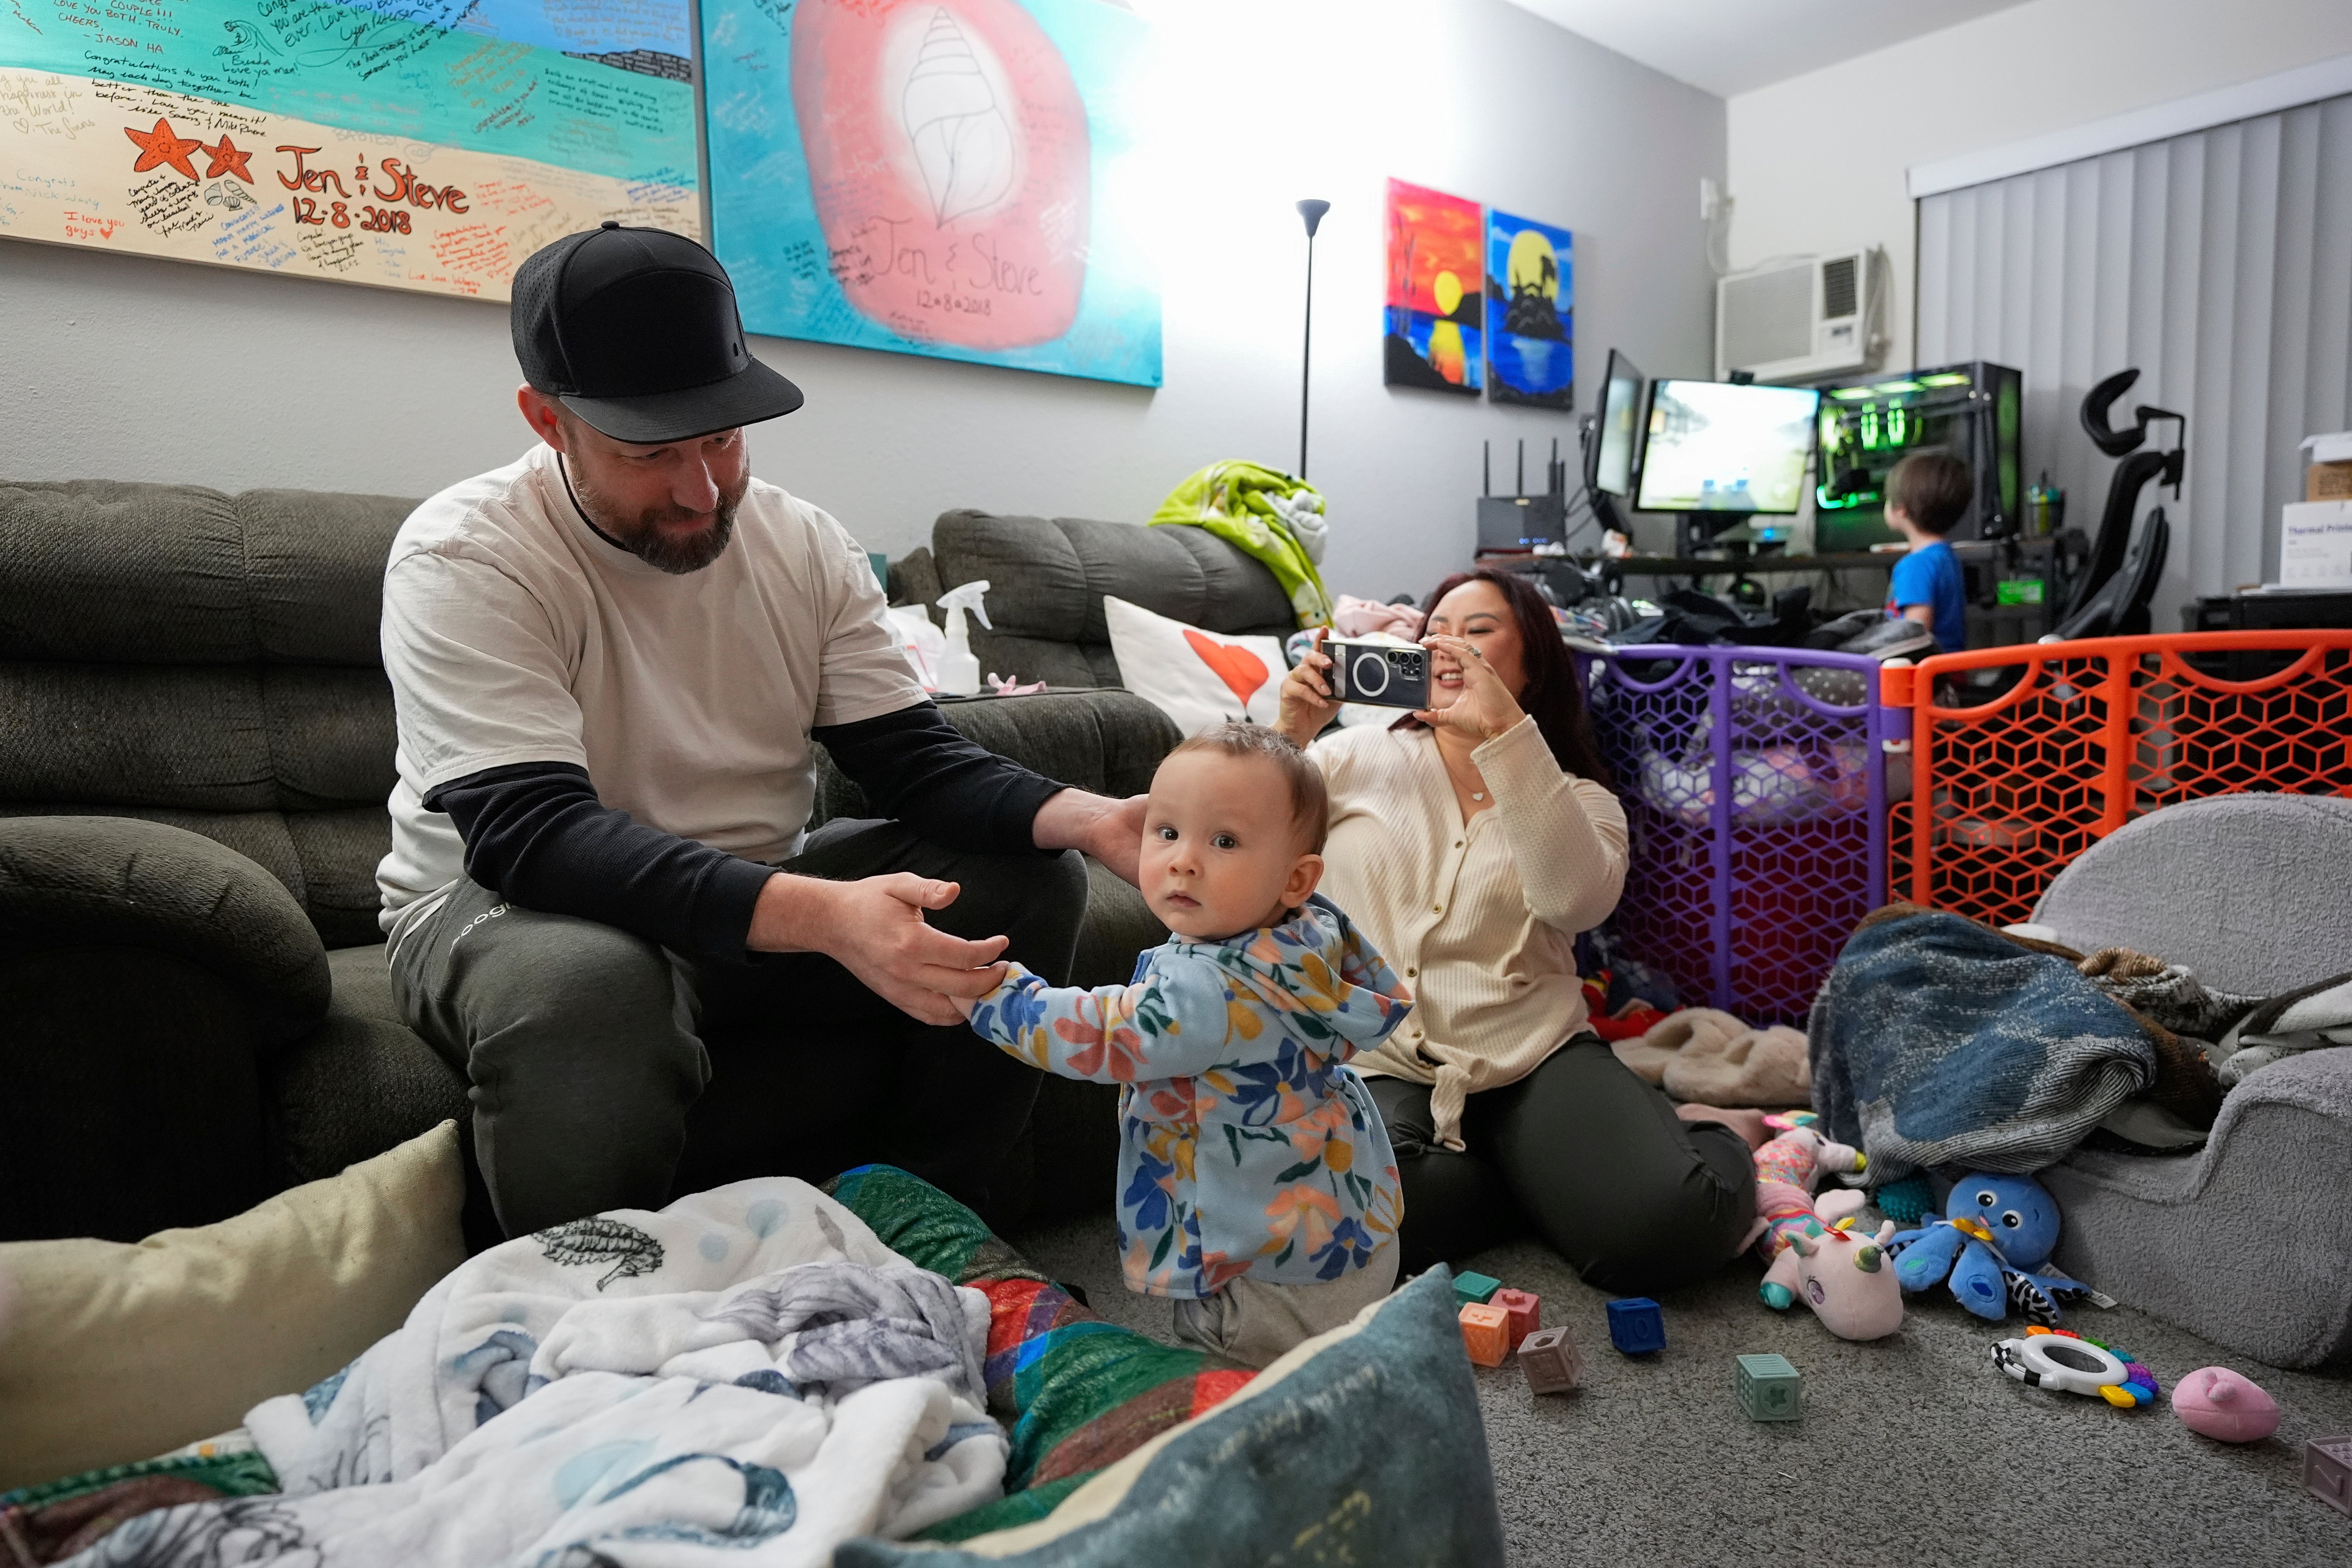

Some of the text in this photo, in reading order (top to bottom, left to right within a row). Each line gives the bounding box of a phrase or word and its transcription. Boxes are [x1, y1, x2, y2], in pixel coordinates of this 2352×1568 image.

[84, 4, 101, 15] YOU
[58, 13, 103, 32] CHEERS,
[94, 33, 138, 48] JASON
[147, 43, 165, 55] HA
[84, 50, 177, 76] Congratulations
[184, 68, 196, 78] to
[222, 62, 251, 75] Love
[151, 73, 173, 89] day
[92, 79, 137, 92] better
[177, 92, 204, 103] the
[16, 168, 76, 189] Congrats
[275, 145, 352, 198] Jen
[373, 158, 470, 215] Steve
[25, 189, 59, 200] Nick
[63, 211, 125, 230] I love you
[64, 225, 96, 240] guys
[868, 214, 937, 285] Jen
[968, 232, 1043, 296] Steve
